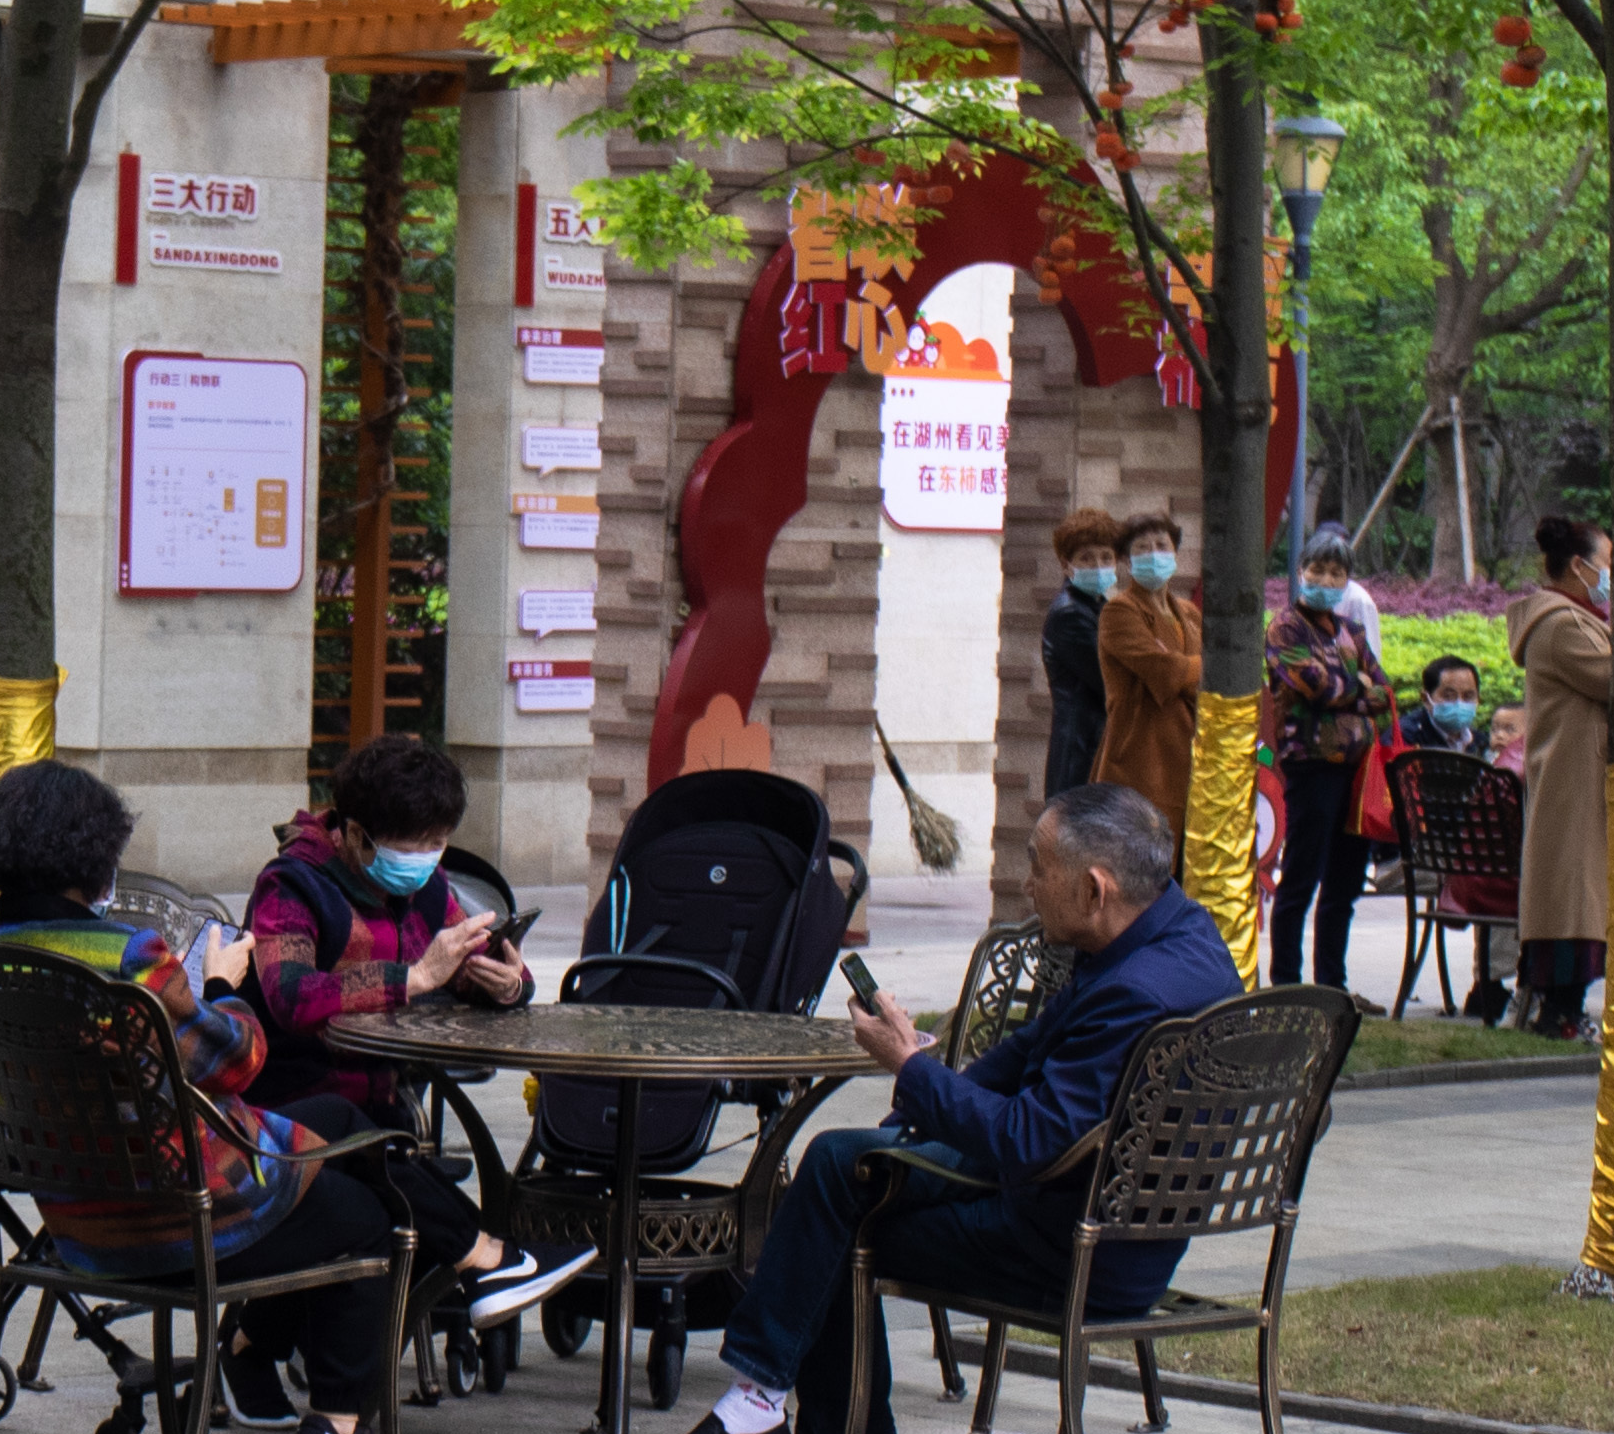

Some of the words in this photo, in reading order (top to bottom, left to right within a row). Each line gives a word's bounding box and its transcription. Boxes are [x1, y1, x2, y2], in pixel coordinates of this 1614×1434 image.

[151, 178, 257, 215] 三大行动
[153, 247, 280, 268] SANDAXINGDONG
[781, 280, 909, 378] 红心
